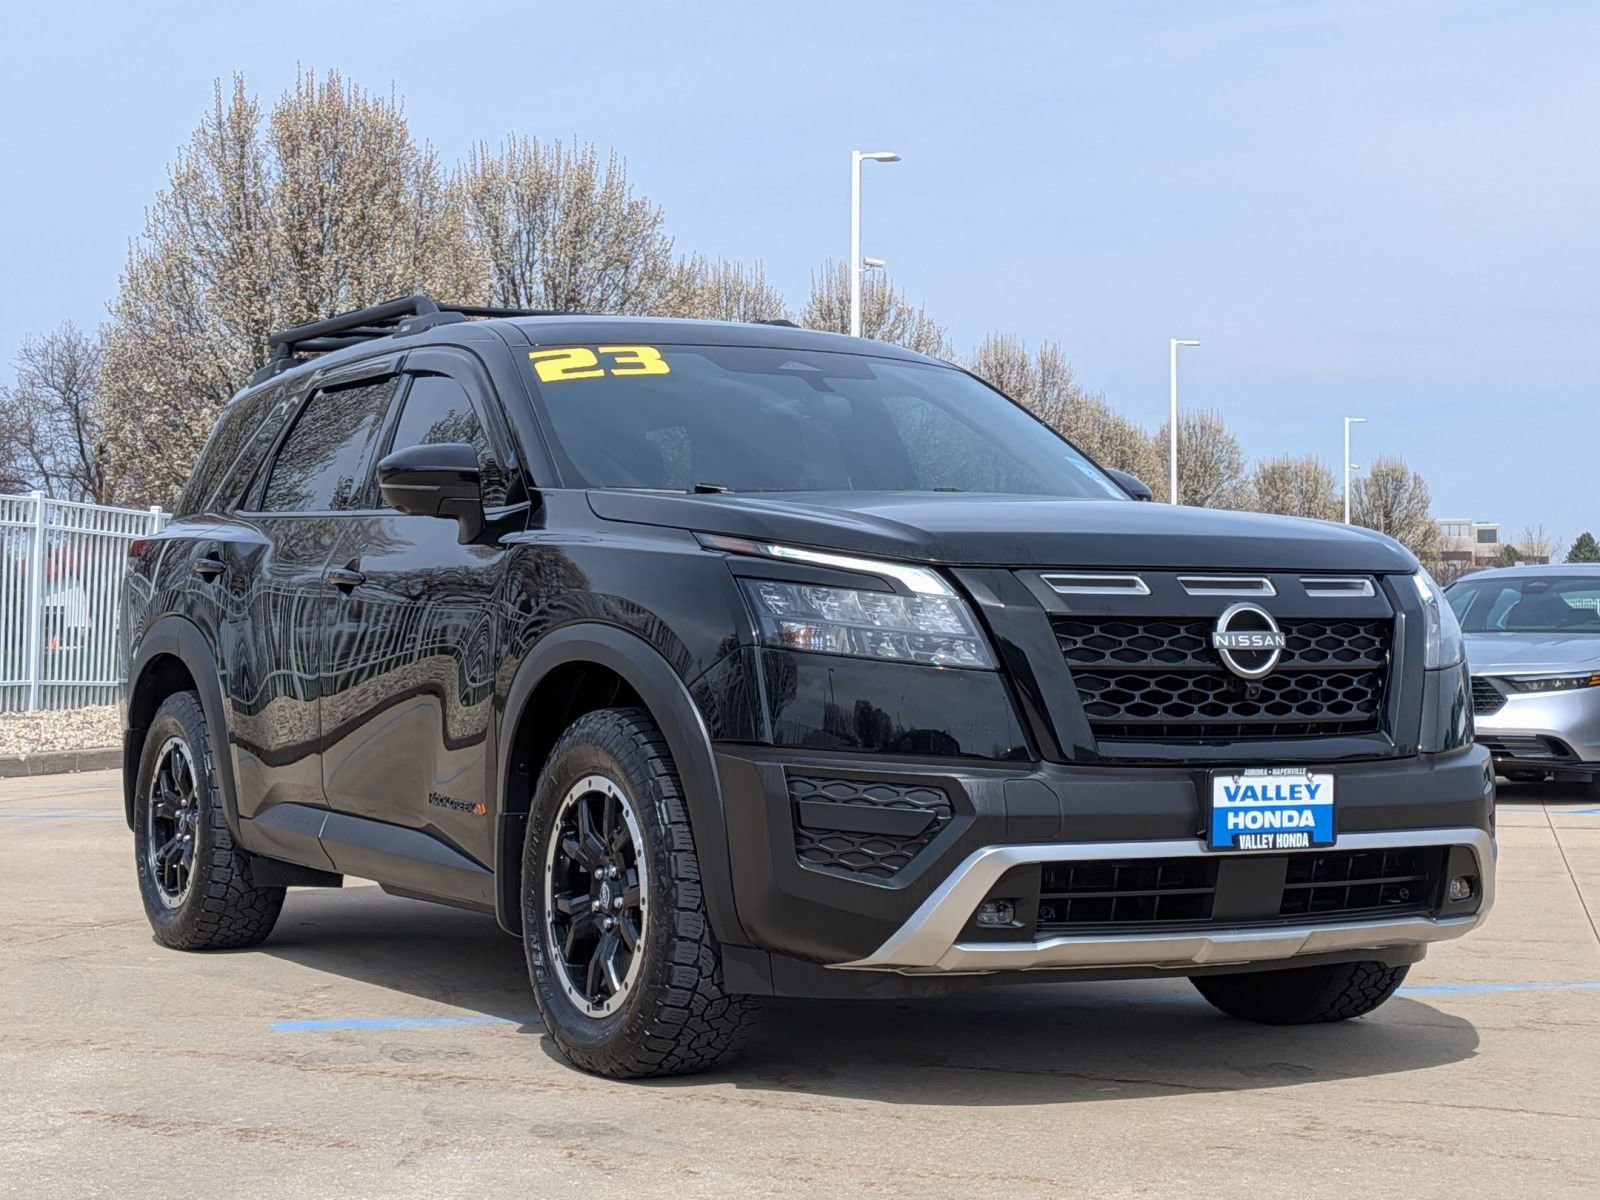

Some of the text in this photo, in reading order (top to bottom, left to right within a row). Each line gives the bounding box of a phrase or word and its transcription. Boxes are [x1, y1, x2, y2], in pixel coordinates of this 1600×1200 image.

[528, 346, 670, 383] 23
[1215, 635, 1285, 647] NISSAN
[1223, 783, 1321, 802] VALLEY
[1227, 809, 1315, 830] HONDA
[1239, 832, 1309, 850] VALLEY HONDA
